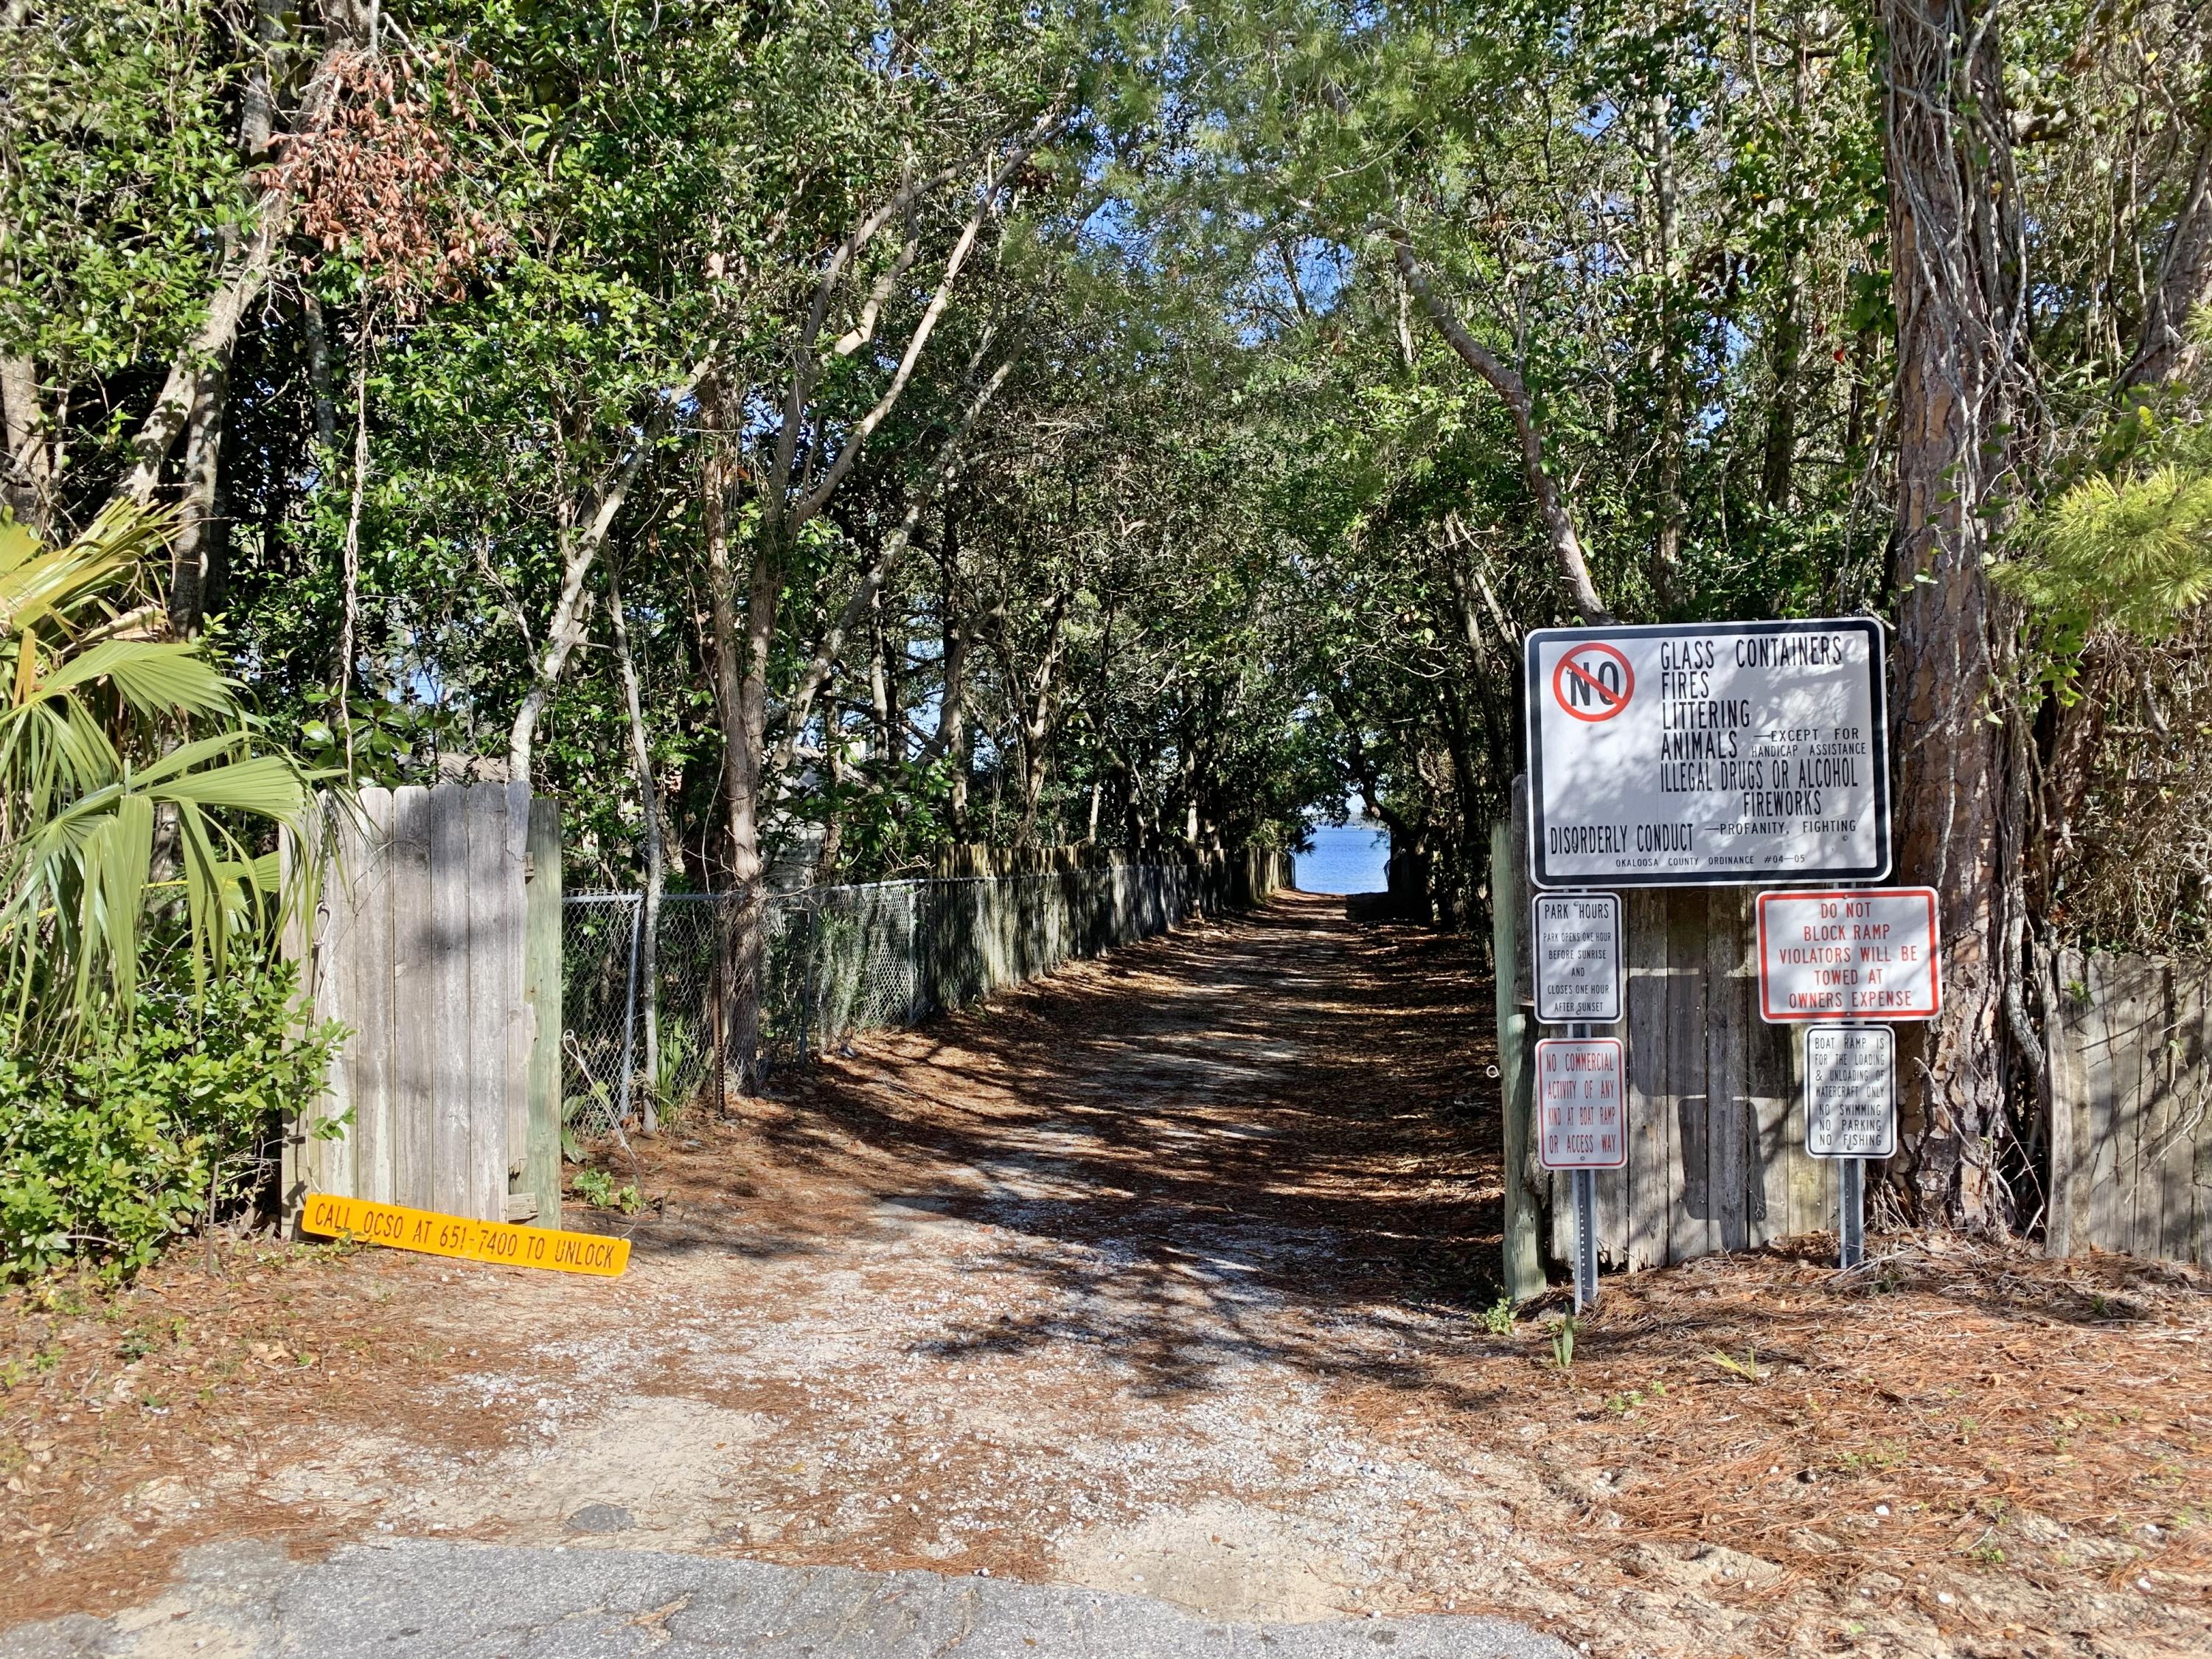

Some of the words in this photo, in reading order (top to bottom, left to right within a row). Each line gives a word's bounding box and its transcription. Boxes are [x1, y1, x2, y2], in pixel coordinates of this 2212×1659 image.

[1661, 641, 1714, 670] GLASS
[1736, 636, 1842, 668] CONTAINERS
[1570, 661, 1619, 706] NO
[1662, 672, 1708, 699] FIRES
[1663, 700, 1750, 730] LITTERING
[1835, 728, 1858, 740] FOR
[1661, 731, 1737, 760] ANIMALS
[1752, 745, 1798, 757] HANDICAP
[1809, 742, 1865, 755] ASSISTANCE
[1661, 762, 1712, 793] ILLEGAL
[1721, 760, 1763, 790] DRUGS
[1773, 759, 1788, 788] OR
[1800, 758, 1858, 787] ALCOHOL
[1744, 792, 1821, 817] FIREWORKS
[1551, 824, 1627, 855] DISORDERLY
[1638, 824, 1693, 852] CONDUCT
[1804, 820, 1855, 833] FIGHTING
[1616, 856, 1658, 867] OKALOOSA
[1669, 856, 1699, 866] COUNTY
[1708, 855, 1754, 865] ORDINANCE
[1545, 905, 1568, 919] PARK
[1579, 904, 1609, 919] HOURS
[1821, 903, 1837, 918] DO
[1847, 902, 1871, 917] NOT
[1543, 933, 1559, 942] PARK
[1562, 933, 1580, 942] OPENS
[1582, 933, 1593, 942] ONE
[1596, 933, 1611, 942] HOUR
[1804, 926, 1845, 941] BLOCK
[1854, 925, 1890, 939] RAMP
[1549, 950, 1574, 959] BEFORE
[1578, 950, 1606, 959] SUNRISE
[1779, 947, 1851, 964] VIOLATORS
[1860, 947, 1891, 962] WILL
[1902, 946, 1917, 961] BE
[1571, 967, 1585, 977] AND
[1815, 970, 1858, 985] TOWED
[1868, 969, 1882, 984] AT
[1548, 985, 1573, 995] CLOSES
[1576, 985, 1589, 994] ONE
[1591, 985, 1609, 994] HOUR
[1554, 1002, 1574, 1012] AFTER
[1578, 1002, 1603, 1012] SUNSET
[1790, 992, 1842, 1009] OWNERS
[1852, 991, 1912, 1006] EXPENSE
[1815, 1038, 1834, 1049] BOAT
[1844, 1037, 1866, 1048] RAMP
[1877, 1037, 1885, 1048] IS
[1547, 1054, 1556, 1072] NO
[1565, 1053, 1613, 1072] COMMERCIAL
[1815, 1054, 1827, 1065] FOR
[1836, 1054, 1846, 1065] THE
[1855, 1054, 1885, 1065] LOADING
[1816, 1071, 1822, 1081] &
[1830, 1070, 1868, 1081] UNLOADING
[1876, 1070, 1885, 1080] OF
[1548, 1081, 1576, 1099] ACTIVITY
[1585, 1080, 1592, 1099] OF
[1601, 1080, 1614, 1099] ANY
[1816, 1086, 1858, 1098] WATERCRAFT
[1867, 1086, 1885, 1097] ONLY
[1549, 1108, 1561, 1126] KIND
[1568, 1108, 1573, 1126] AT
[1580, 1107, 1593, 1126] BOAT
[1600, 1107, 1615, 1125] RAMP
[1820, 1105, 1829, 1116] NO
[1840, 1105, 1881, 1116] SWIMMING
[1820, 1120, 1831, 1130] NO
[1842, 1120, 1881, 1130] PARKING
[1549, 1135, 1558, 1153] OR
[1567, 1135, 1593, 1153] ACCESS
[1601, 1134, 1615, 1152] WAY
[1820, 1135, 1832, 1146] NO
[1843, 1135, 1881, 1146] FISHING
[316, 1203, 349, 1230] CALL
[364, 1211, 403, 1238] OCSO
[412, 1220, 431, 1244] AT
[440, 1225, 517, 1256] 651-7400
[527, 1237, 544, 1259] TO
[555, 1239, 615, 1268] UNLOCK
